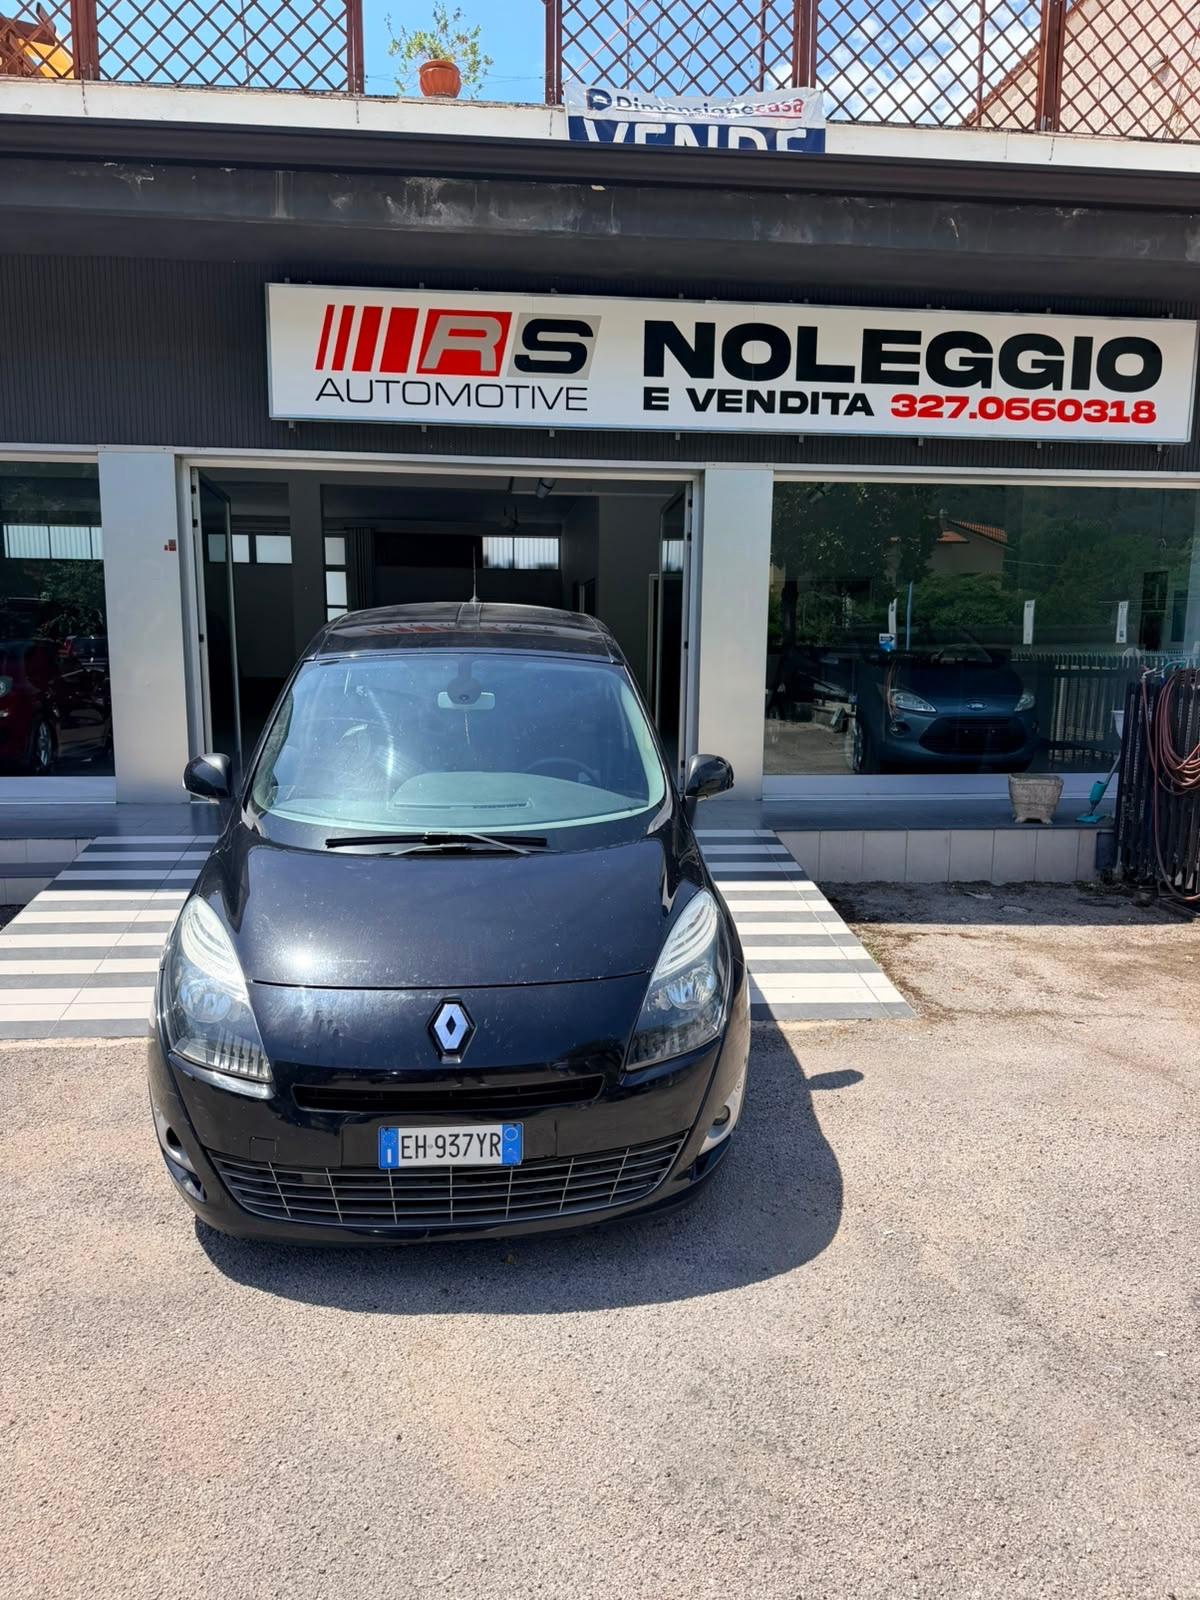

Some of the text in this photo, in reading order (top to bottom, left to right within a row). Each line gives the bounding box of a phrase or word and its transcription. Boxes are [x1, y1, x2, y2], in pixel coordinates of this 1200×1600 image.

[421, 315, 595, 375] RS
[643, 319, 1163, 393] NOLEGGIO
[314, 377, 588, 411] AUTOMOTIVE
[643, 386, 1157, 424] E VENDITA 327.0660318
